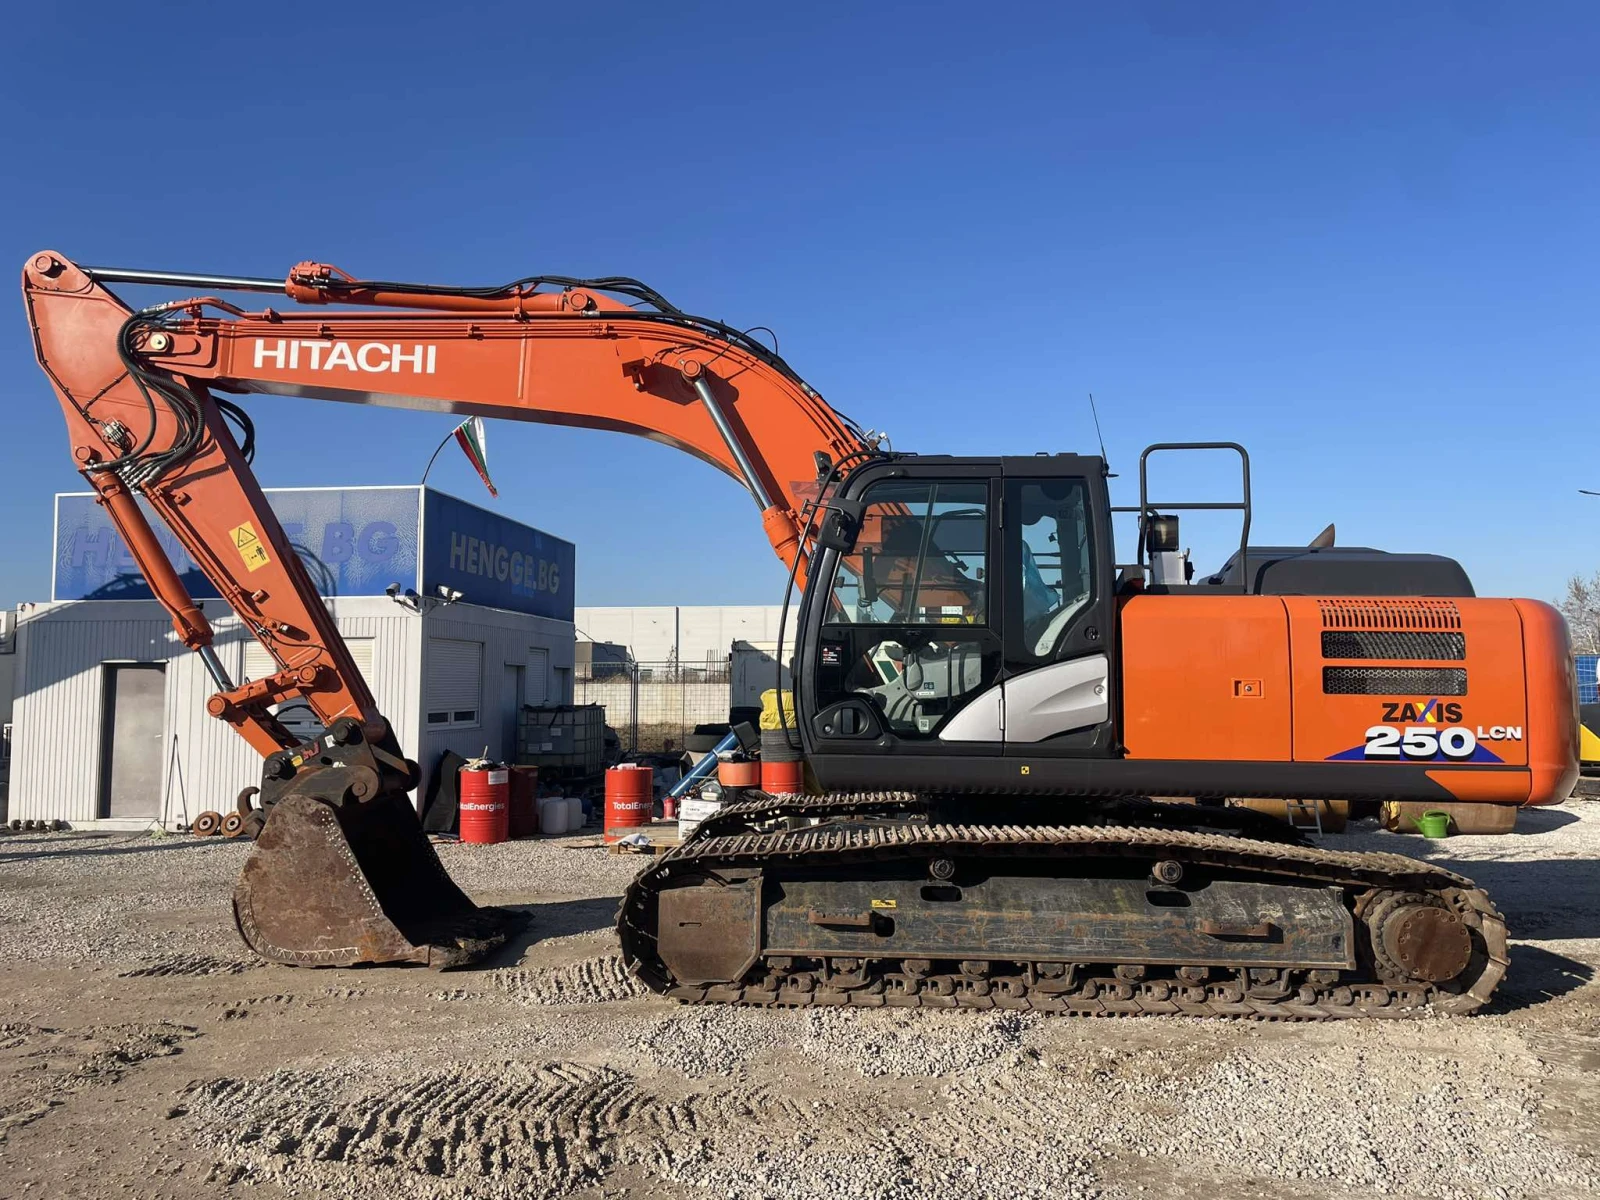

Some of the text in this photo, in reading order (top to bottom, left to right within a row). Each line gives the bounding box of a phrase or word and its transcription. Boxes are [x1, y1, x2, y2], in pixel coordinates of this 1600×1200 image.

[253, 339, 437, 374] HITACHI
[450, 531, 560, 594] HENGGE.BG
[1382, 699, 1463, 723] ZAXIS
[1364, 725, 1522, 759] 250 LCN
